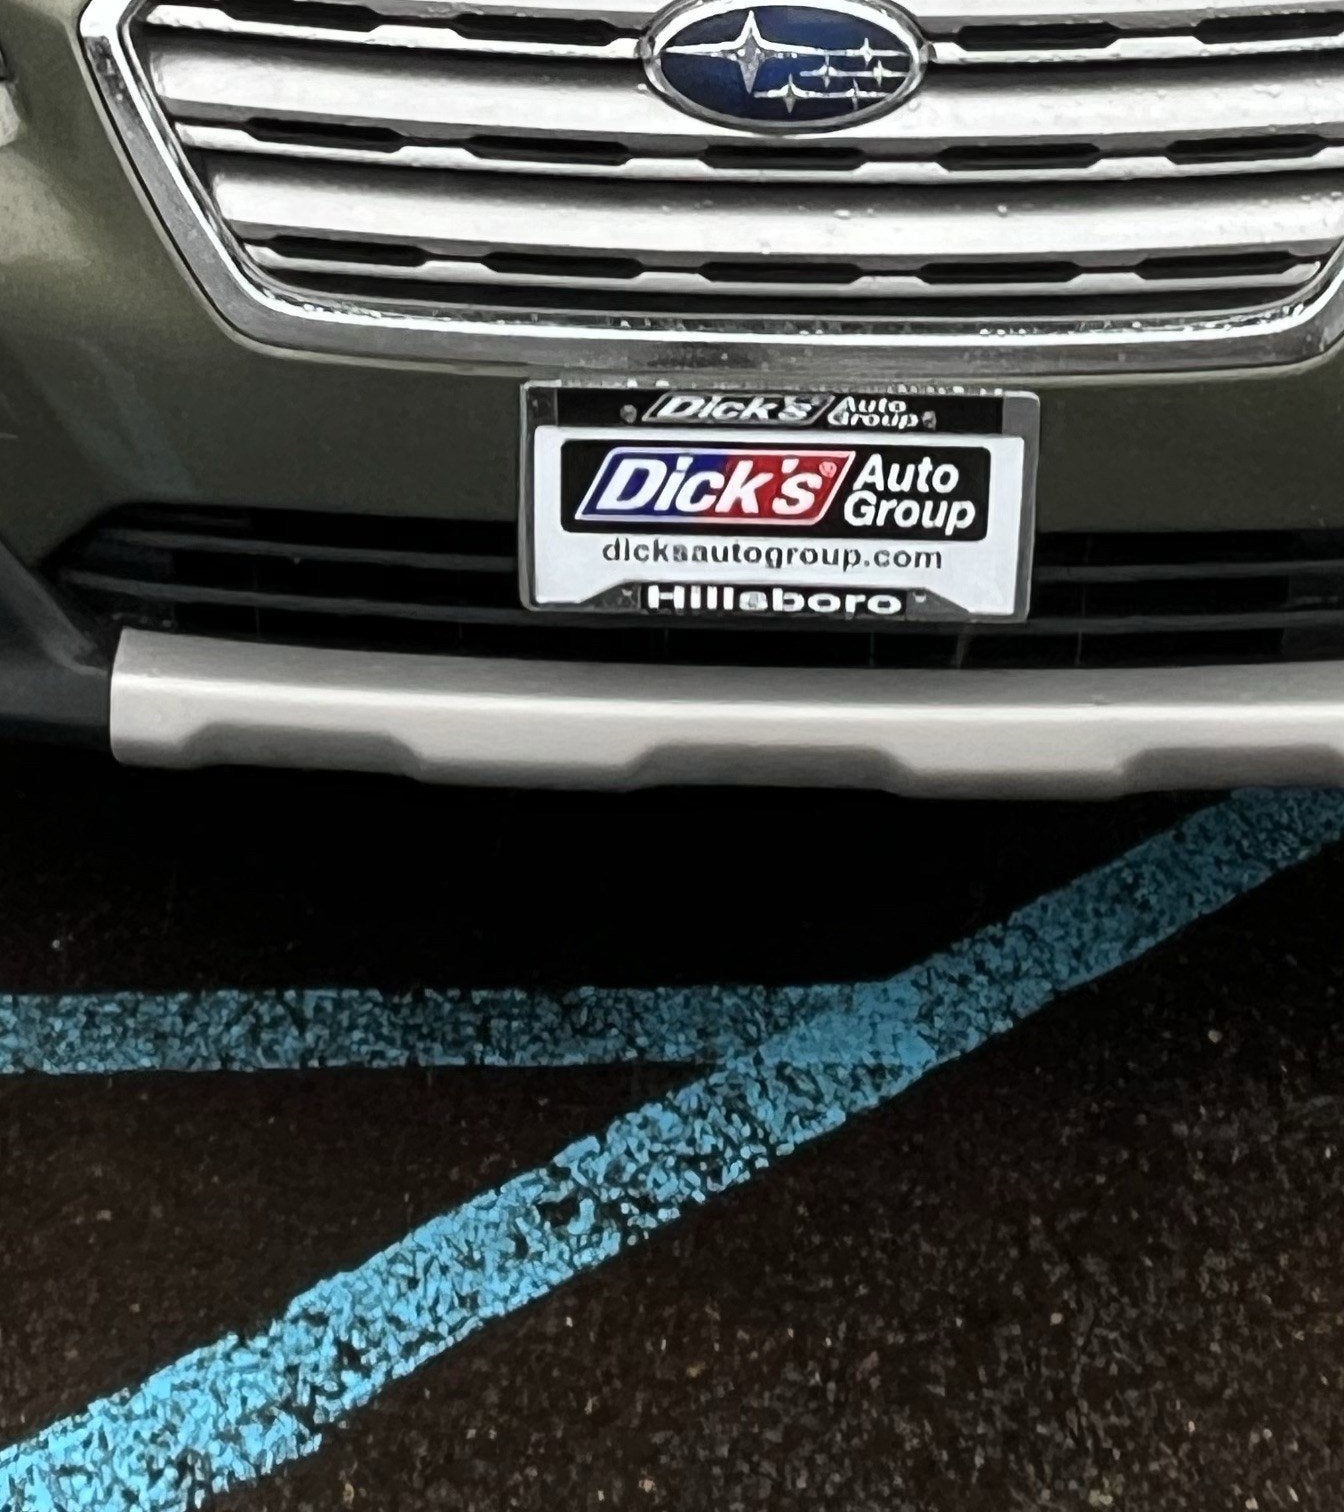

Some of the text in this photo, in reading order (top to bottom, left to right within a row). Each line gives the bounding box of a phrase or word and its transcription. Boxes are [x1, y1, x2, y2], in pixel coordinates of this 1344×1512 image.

[656, 395, 907, 421] Dick's Auto
[594, 453, 960, 516] Dick's Auto
[843, 490, 976, 536] Group
[602, 537, 943, 572] dicksautogroup.com
[647, 584, 903, 618] Hillsboro
